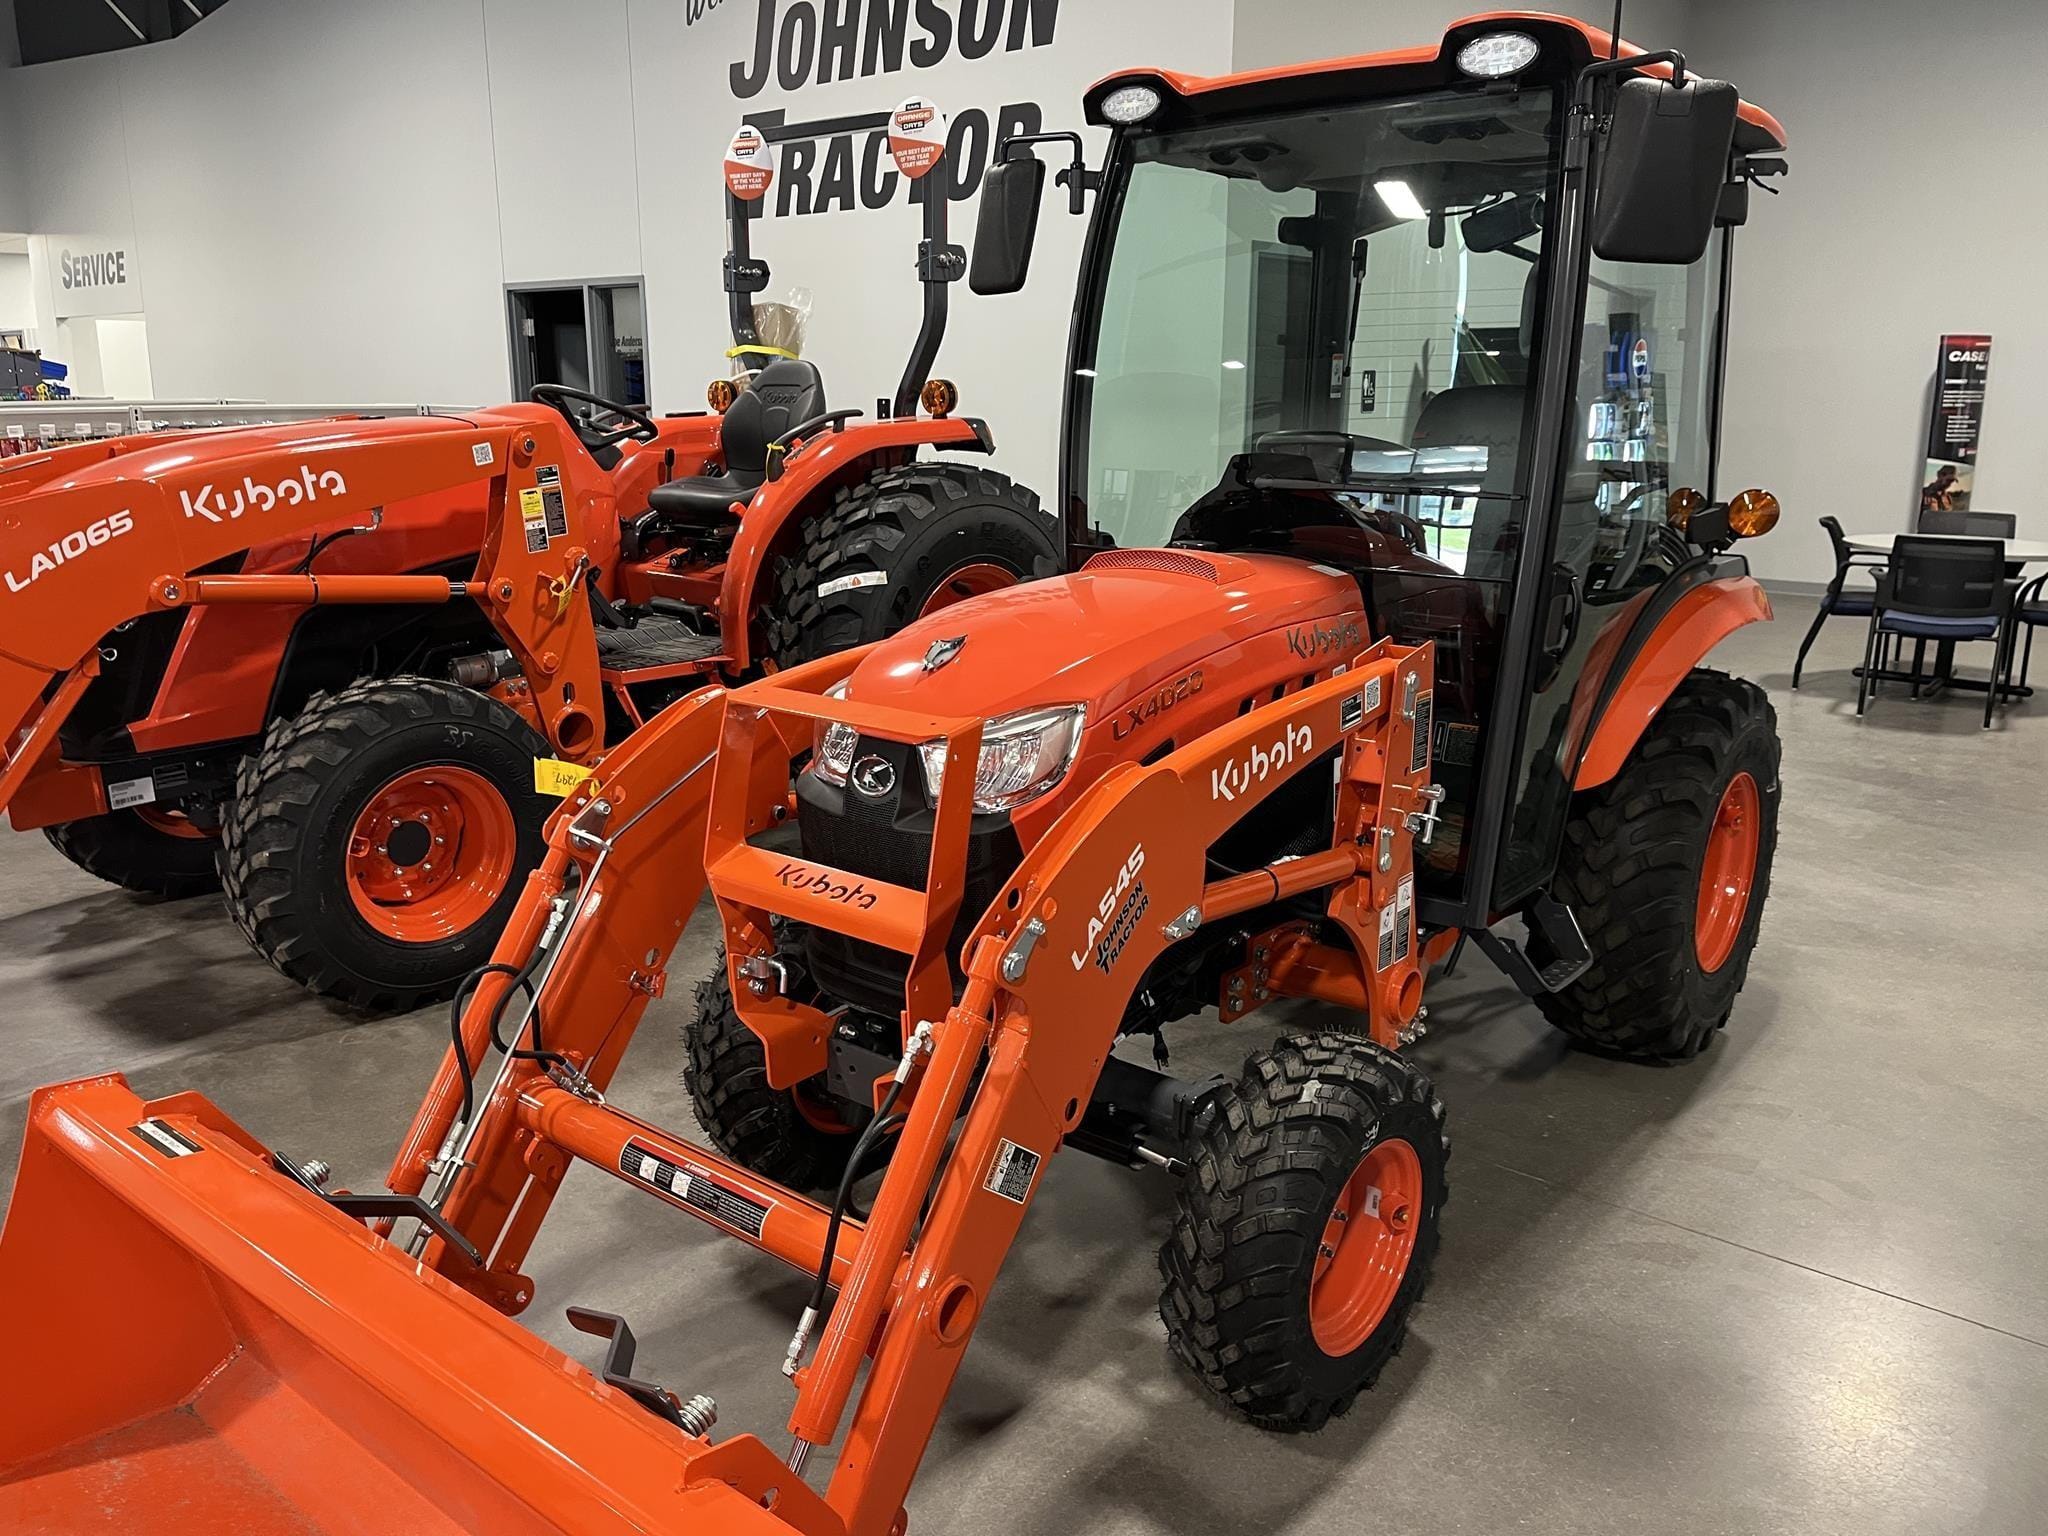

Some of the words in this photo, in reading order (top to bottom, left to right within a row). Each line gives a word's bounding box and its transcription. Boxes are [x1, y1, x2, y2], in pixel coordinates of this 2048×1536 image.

[729, 0, 1059, 99] JOHNSON
[897, 112, 931, 122] ORANGE
[61, 249, 126, 290] SERVICE
[1948, 350, 1986, 362] CASE
[179, 464, 347, 523] Kubota
[4, 509, 134, 592] LA1065
[1286, 619, 1361, 660] Kubota
[1112, 670, 1204, 741] LX4020
[1211, 723, 1313, 801] Kubota
[774, 863, 878, 910] Kubota
[1071, 842, 1145, 971] LA545
[1095, 881, 1144, 967] JOHNSON
[1100, 894, 1149, 975] TRACTOR
